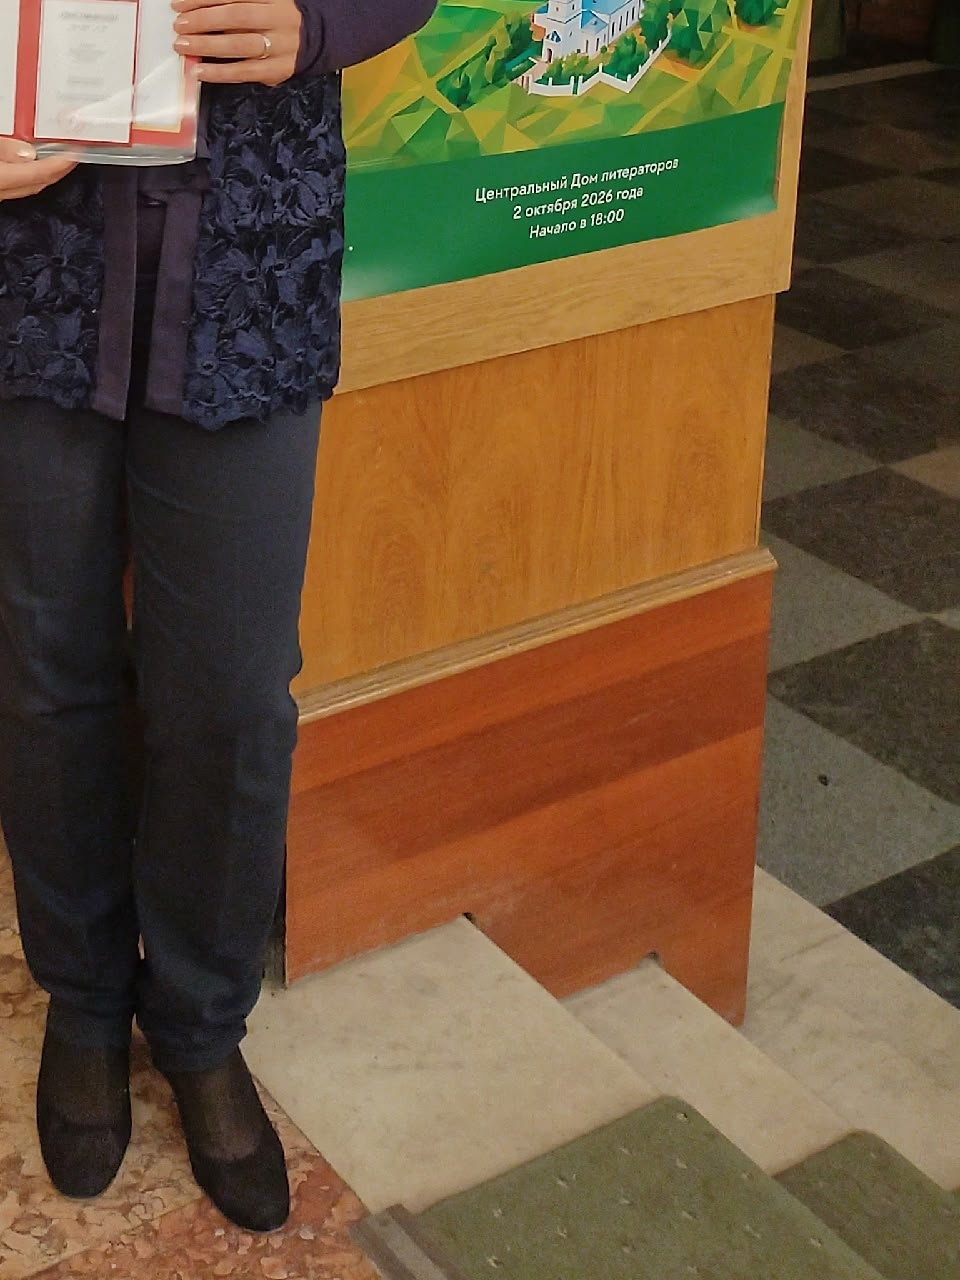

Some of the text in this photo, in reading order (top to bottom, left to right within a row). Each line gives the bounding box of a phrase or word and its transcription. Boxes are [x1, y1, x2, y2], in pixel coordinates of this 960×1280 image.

[475, 158, 678, 203] Центральный Дом литераторов
[513, 187, 643, 219] 2 октября 2026 года
[529, 208, 624, 238] Начало в 18:00
